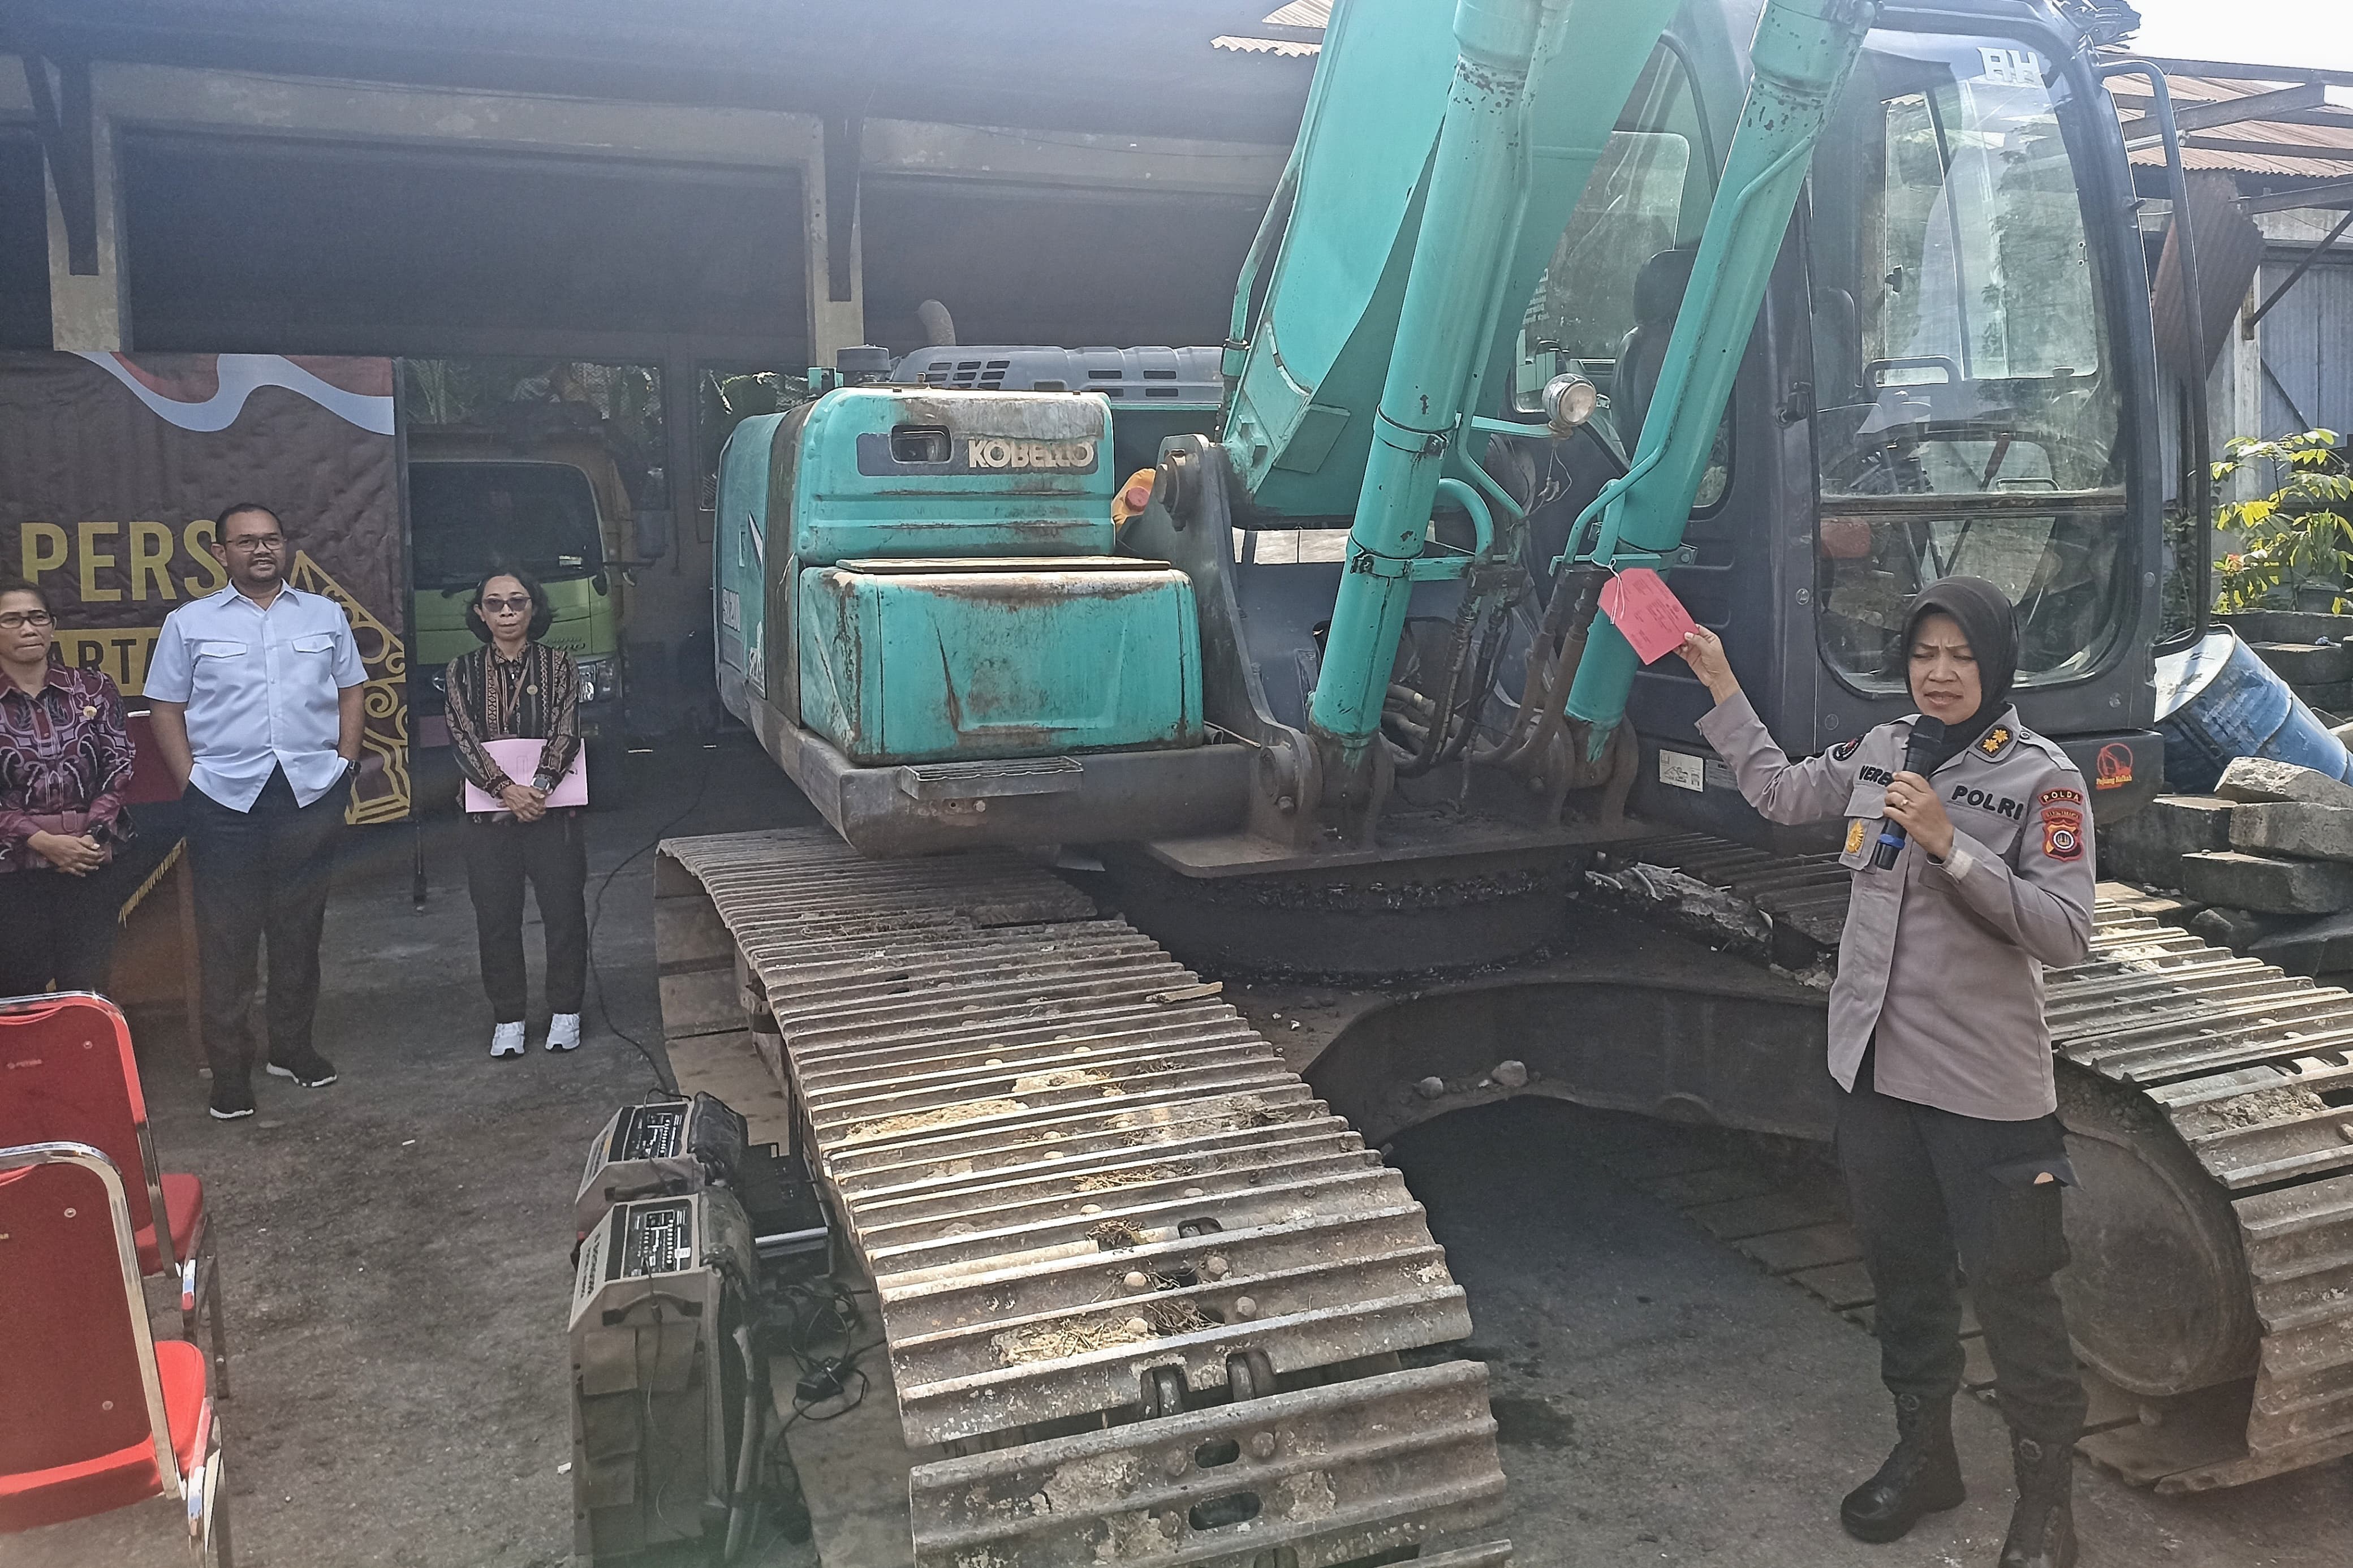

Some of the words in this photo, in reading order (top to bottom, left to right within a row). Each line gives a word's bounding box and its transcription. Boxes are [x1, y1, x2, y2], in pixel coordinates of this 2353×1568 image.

[20, 519, 227, 602] PERS
[1951, 785, 2024, 820] POLRI
[2042, 791, 2079, 802] POLDA
